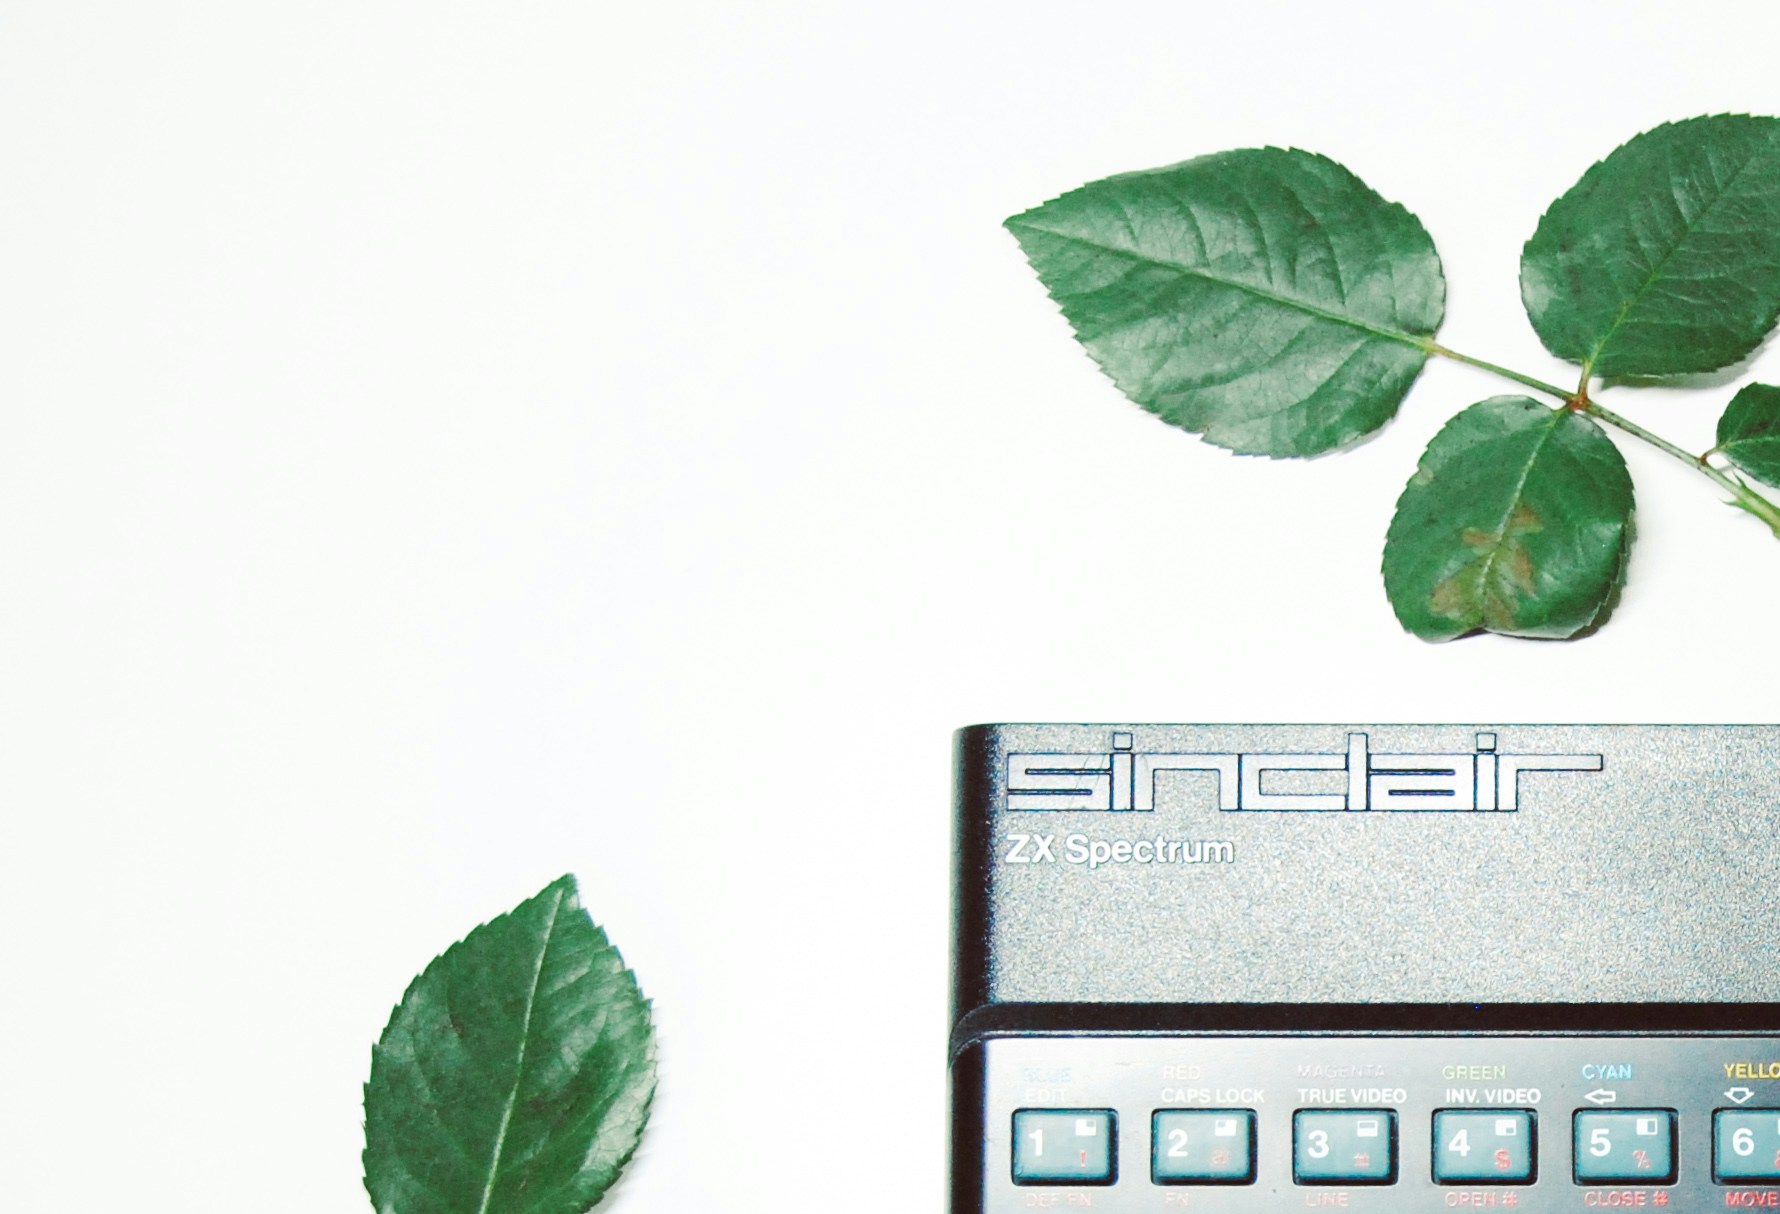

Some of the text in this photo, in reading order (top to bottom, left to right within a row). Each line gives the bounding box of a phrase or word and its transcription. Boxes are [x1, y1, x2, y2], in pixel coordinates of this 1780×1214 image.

[1007, 732, 1603, 812] sinclair
[1004, 834, 1235, 869] ZX Spectrum
[1163, 1066, 1200, 1081] RED
[1298, 1065, 1385, 1079] MAGENTA
[1442, 1066, 1506, 1081] GREEN
[1582, 1064, 1632, 1080] CYAN
[1162, 1088, 1264, 1103] CAPS LOCK
[1300, 1088, 1407, 1104] TRUE VIDEO
[1446, 1089, 1541, 1104] INV. VIDEO
[1029, 1129, 1043, 1156] 1
[1168, 1129, 1188, 1157] 2
[1308, 1131, 1329, 1158] 3
[1449, 1129, 1470, 1156] 4
[1590, 1129, 1611, 1156] 5
[1733, 1128, 1754, 1156] 6
[1306, 1193, 1348, 1207] LINE
[1446, 1192, 1517, 1206] OPEN #
[1585, 1192, 1668, 1206] CLOSE #
[1726, 1192, 1779, 1206] MOVE
